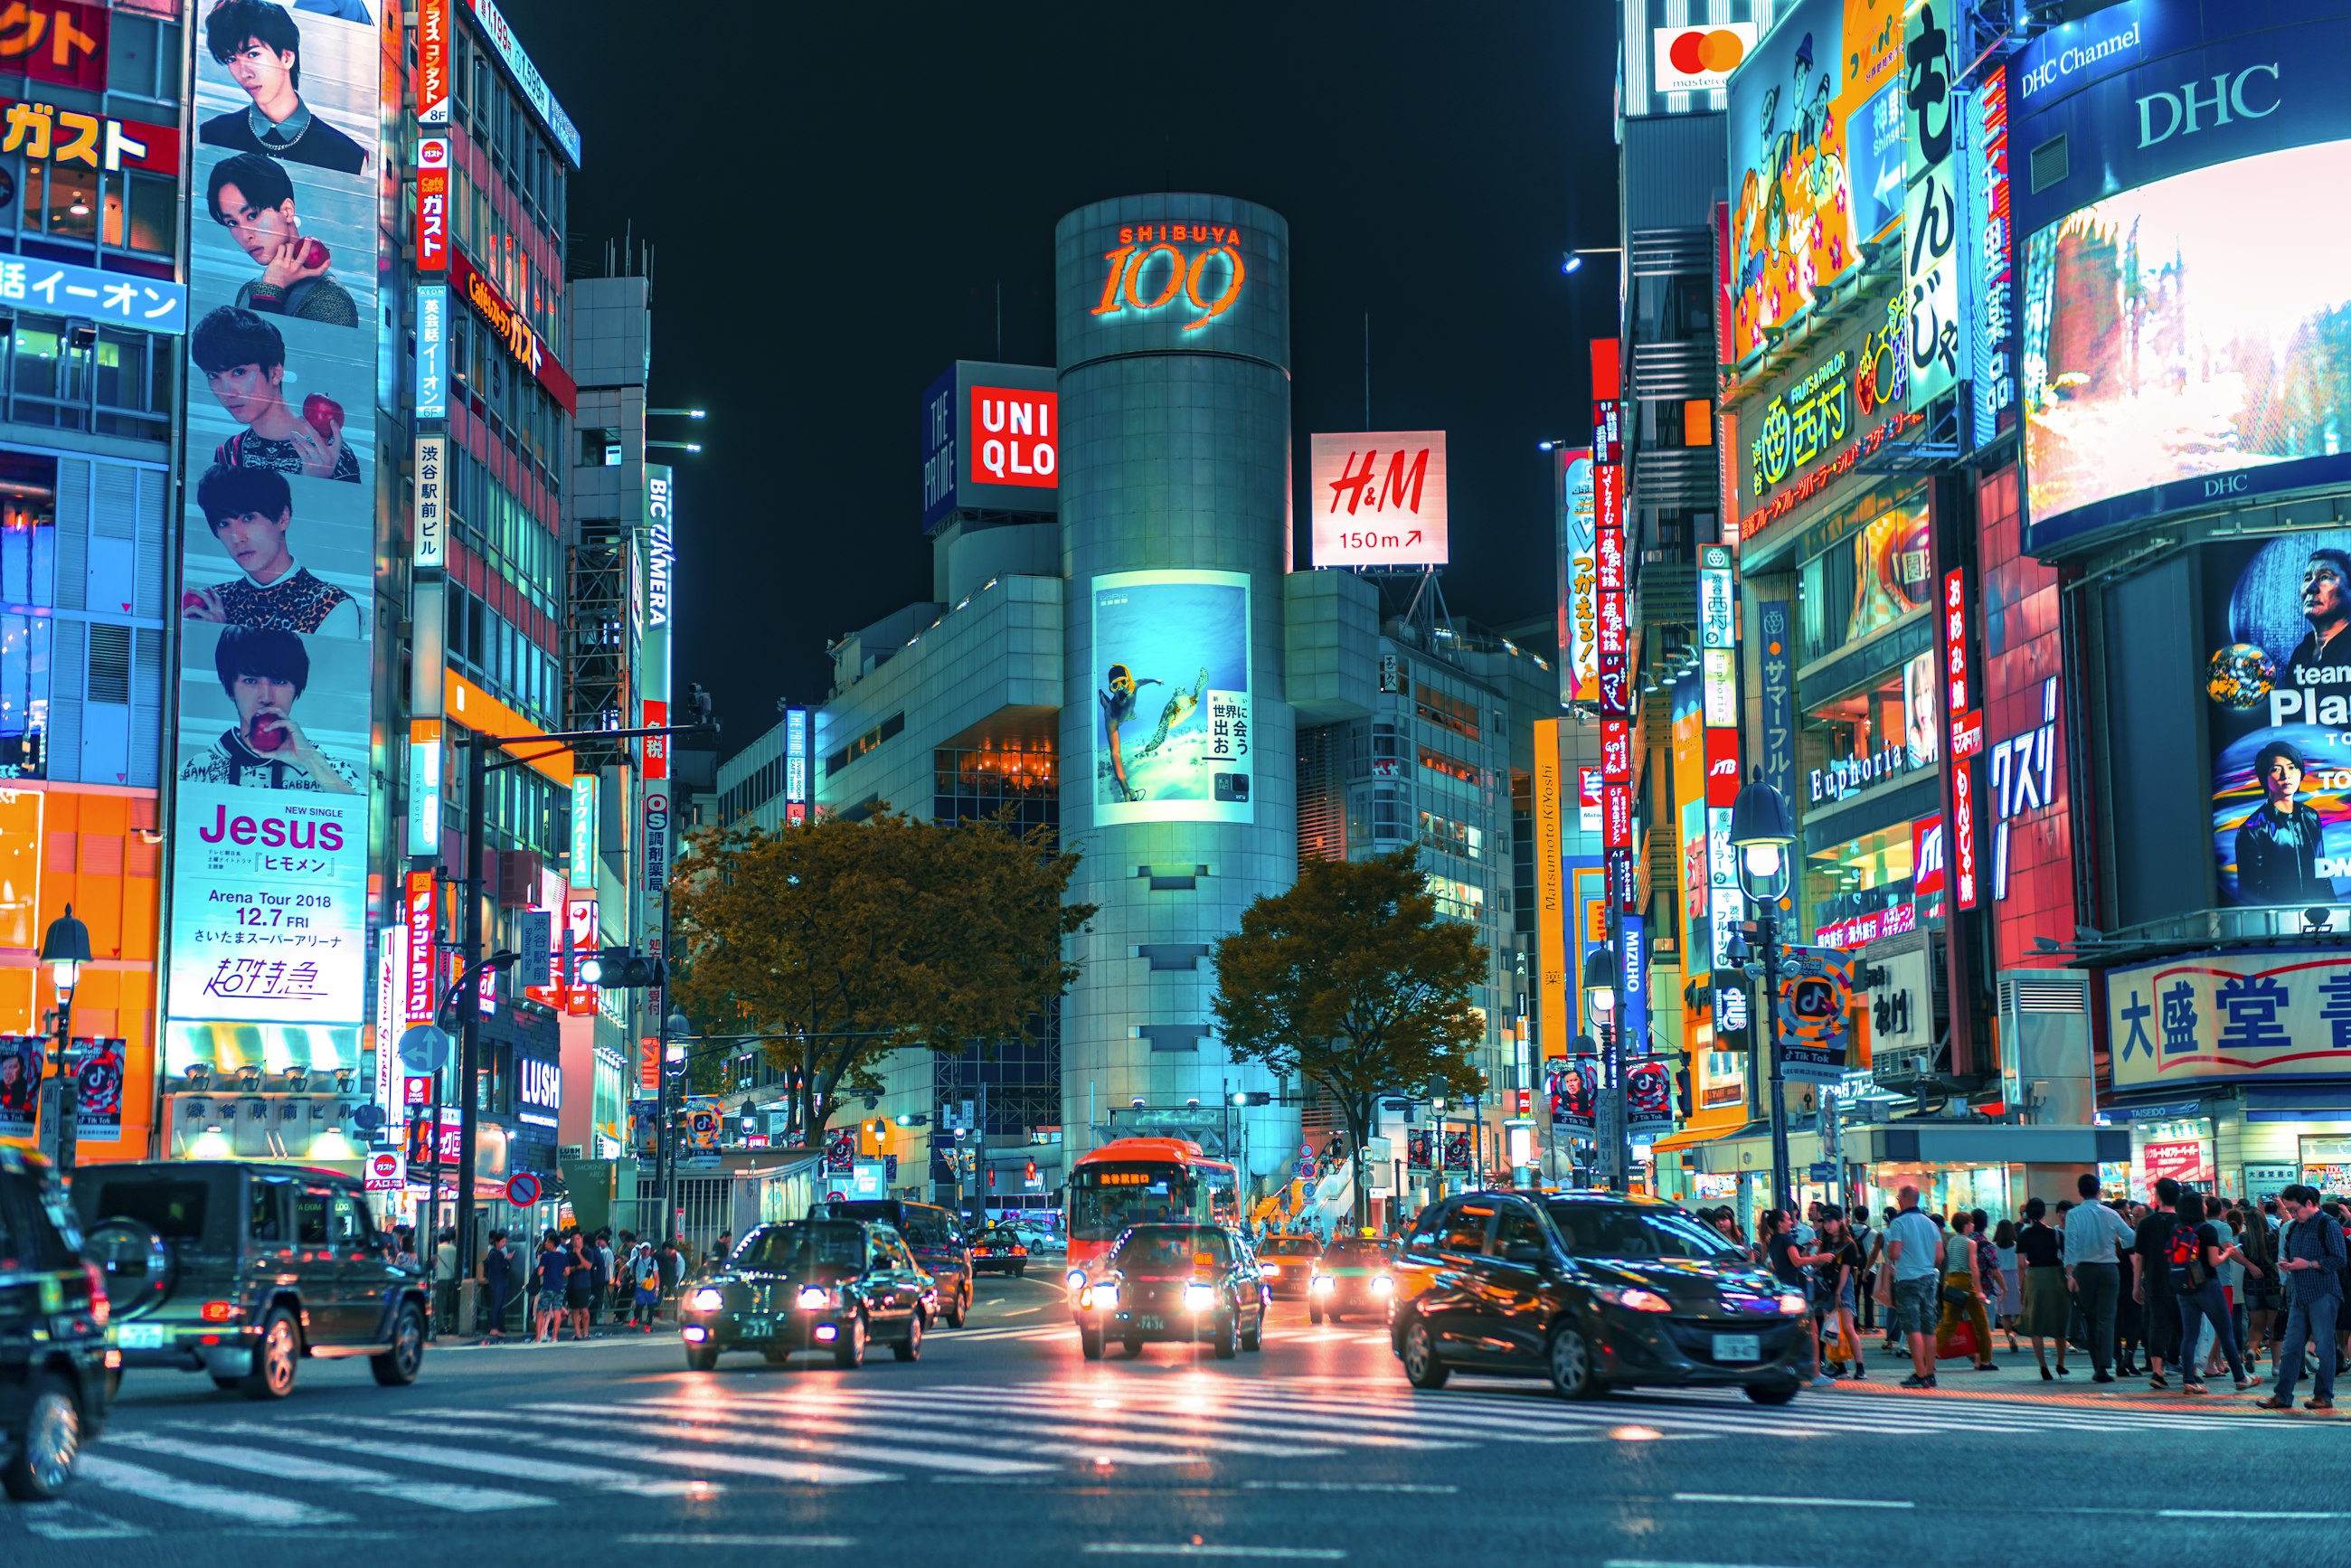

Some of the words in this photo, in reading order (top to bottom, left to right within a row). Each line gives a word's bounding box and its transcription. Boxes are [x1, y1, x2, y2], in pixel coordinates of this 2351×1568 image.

[425, 44, 441, 104] コンタクト
[2021, 59, 2058, 99] DHC
[2060, 23, 2141, 75] Channel
[430, 109, 447, 121] 8F
[2135, 62, 2281, 149] DHC
[2, 101, 147, 172] ガスト
[1873, 120, 1906, 157] Shinsen
[420, 176, 444, 187] Café
[1907, 4, 1960, 378] もんじゃ
[422, 194, 442, 258] ガスト
[1119, 224, 1242, 245] SHIBUYA
[420, 287, 445, 297] AEON
[1091, 241, 1246, 331] 109
[422, 298, 440, 405] 英会話イーオン
[509, 313, 543, 377] ガスト
[422, 408, 439, 418] 6F
[929, 390, 949, 442] THE
[982, 399, 1049, 436] UNI
[1600, 401, 1613, 411] 8F
[982, 440, 1055, 478] QLO
[1601, 466, 1616, 476] 8F
[923, 440, 955, 513] PRIME
[1329, 448, 1430, 516] H&M
[2204, 475, 2249, 498] DHC
[420, 445, 439, 556] 渋谷駅前ビル
[649, 477, 667, 519] BIC
[1338, 531, 1401, 549] 150m
[1603, 528, 1616, 538] 7F
[649, 522, 667, 627] CAMERA
[1100, 592, 1129, 601] GoPro
[1605, 592, 1617, 601] 7F
[1707, 572, 1729, 631] 渋谷西村
[1706, 633, 1718, 643] 5F
[1948, 578, 1965, 710] お好み焼
[1606, 656, 1620, 666] 6F
[1715, 653, 1727, 713] Euphoria
[789, 713, 803, 728] THE
[1212, 704, 1248, 720] 世界に
[1608, 723, 1620, 732] 6F
[789, 729, 803, 756] PRIME
[1710, 759, 1737, 777] JTB
[1809, 743, 1903, 802] Euphoria
[1990, 723, 2056, 818] クスリ
[1610, 787, 1623, 798] 6F
[199, 804, 345, 852] Jesus
[285, 806, 307, 816] NEW
[308, 807, 344, 818] SINGLE
[572, 779, 590, 874] レイクALSA
[1714, 829, 1725, 870] パーラー
[1956, 769, 1974, 902] もんじゃ焼
[647, 830, 665, 893] 調剤薬局
[1543, 822, 1556, 912] Matsumoto
[1715, 873, 1726, 883] 2F
[208, 889, 253, 904] Arena
[259, 892, 291, 907] Tour
[296, 894, 332, 908] 2018
[235, 907, 283, 927] 12.7
[287, 916, 309, 929] FRI
[1846, 919, 1878, 943] 海外旅行
[194, 929, 343, 949] さいたまスーパーアリーナ
[533, 917, 547, 981] 渋谷駅前
[1816, 927, 1845, 949] 国内旅行
[411, 913, 430, 1012] サンドラッグ
[1625, 930, 1639, 993] MIZUHO
[1544, 970, 1562, 986] 薬
[572, 996, 586, 1005] 3F
[1794, 1052, 1809, 1062] Tik
[1810, 1053, 1830, 1064] Tok
[521, 1057, 561, 1110] LUSH
[2130, 1107, 2167, 1119] TAISEIDO
[375, 1162, 395, 1172] ガスト
[373, 1179, 390, 1188] 入口
